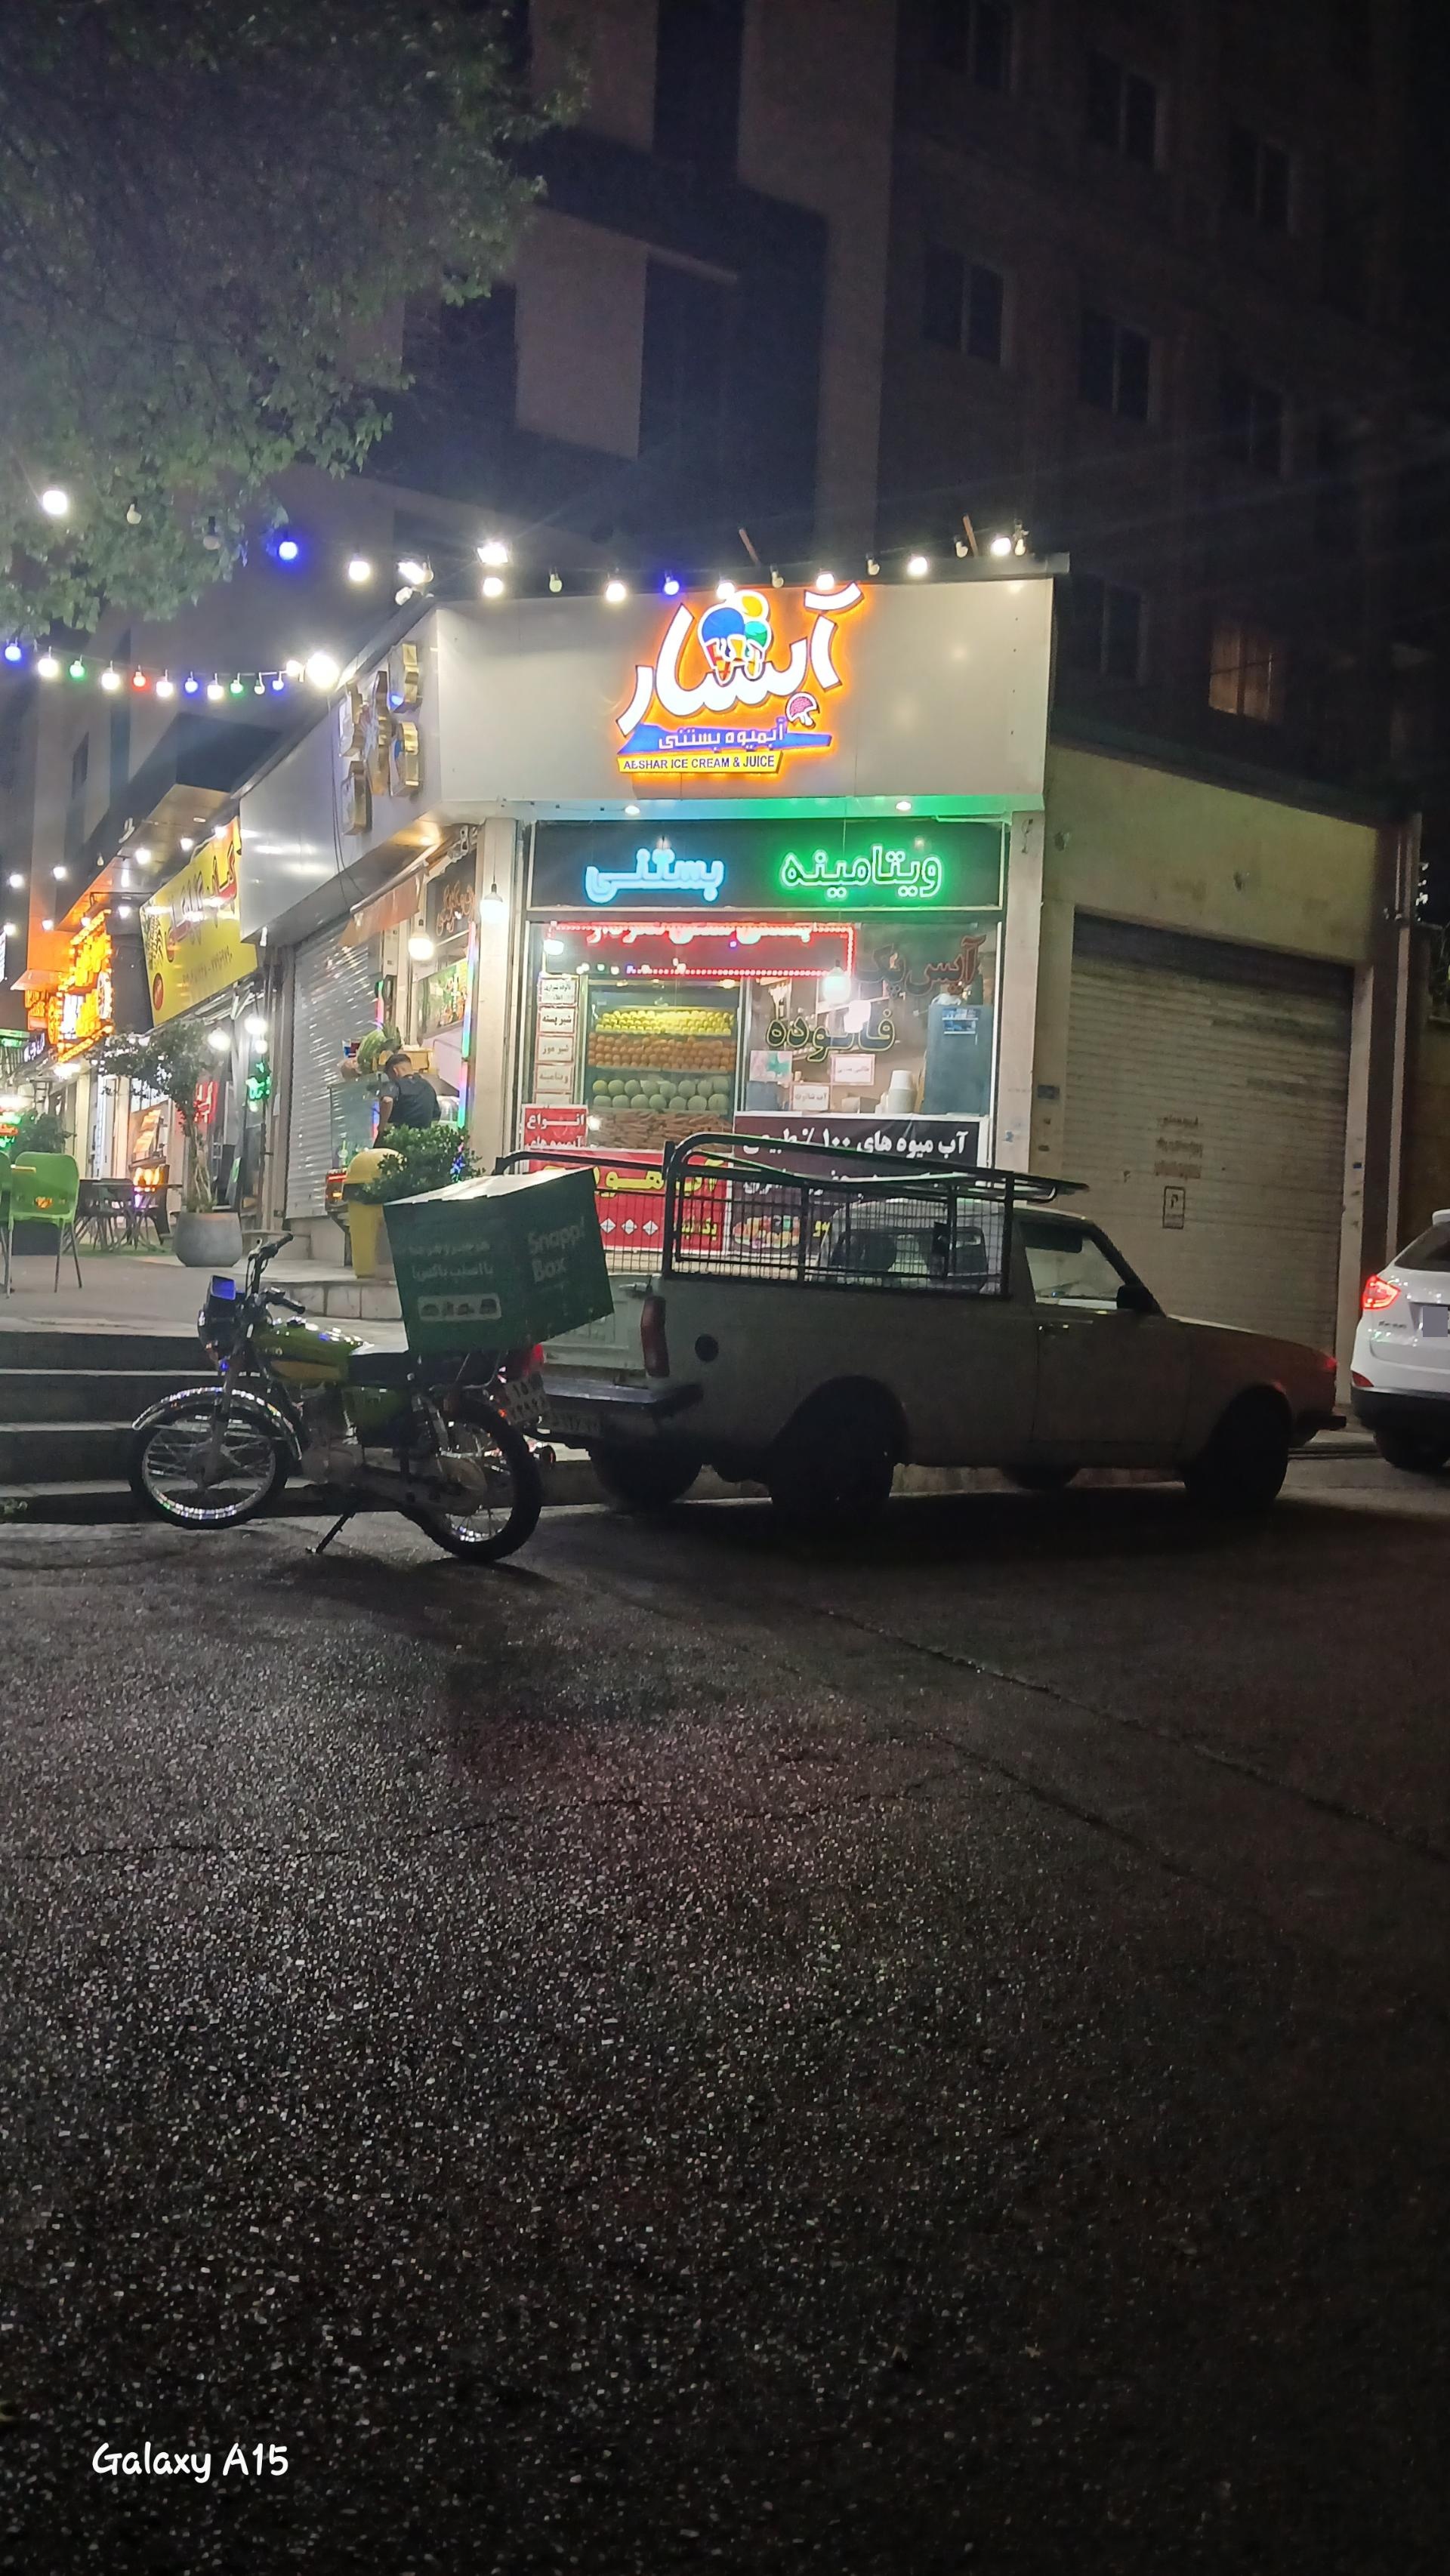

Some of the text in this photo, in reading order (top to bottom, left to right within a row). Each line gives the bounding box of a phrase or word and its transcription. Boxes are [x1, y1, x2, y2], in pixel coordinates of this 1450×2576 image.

[659, 729, 721, 752] بستنی
[671, 758, 688, 769] ICE
[691, 757, 730, 769] CREAM
[733, 756, 740, 768] &
[742, 755, 775, 768] JUICE
[585, 845, 943, 904] ویتامینه بستنی
[526, 1113, 585, 1130] انواع
[856, 1129, 893, 1154] های
[896, 1135, 935, 1159] میوه
[938, 1130, 969, 1159] آب
[532, 1258, 568, 1283] Box
